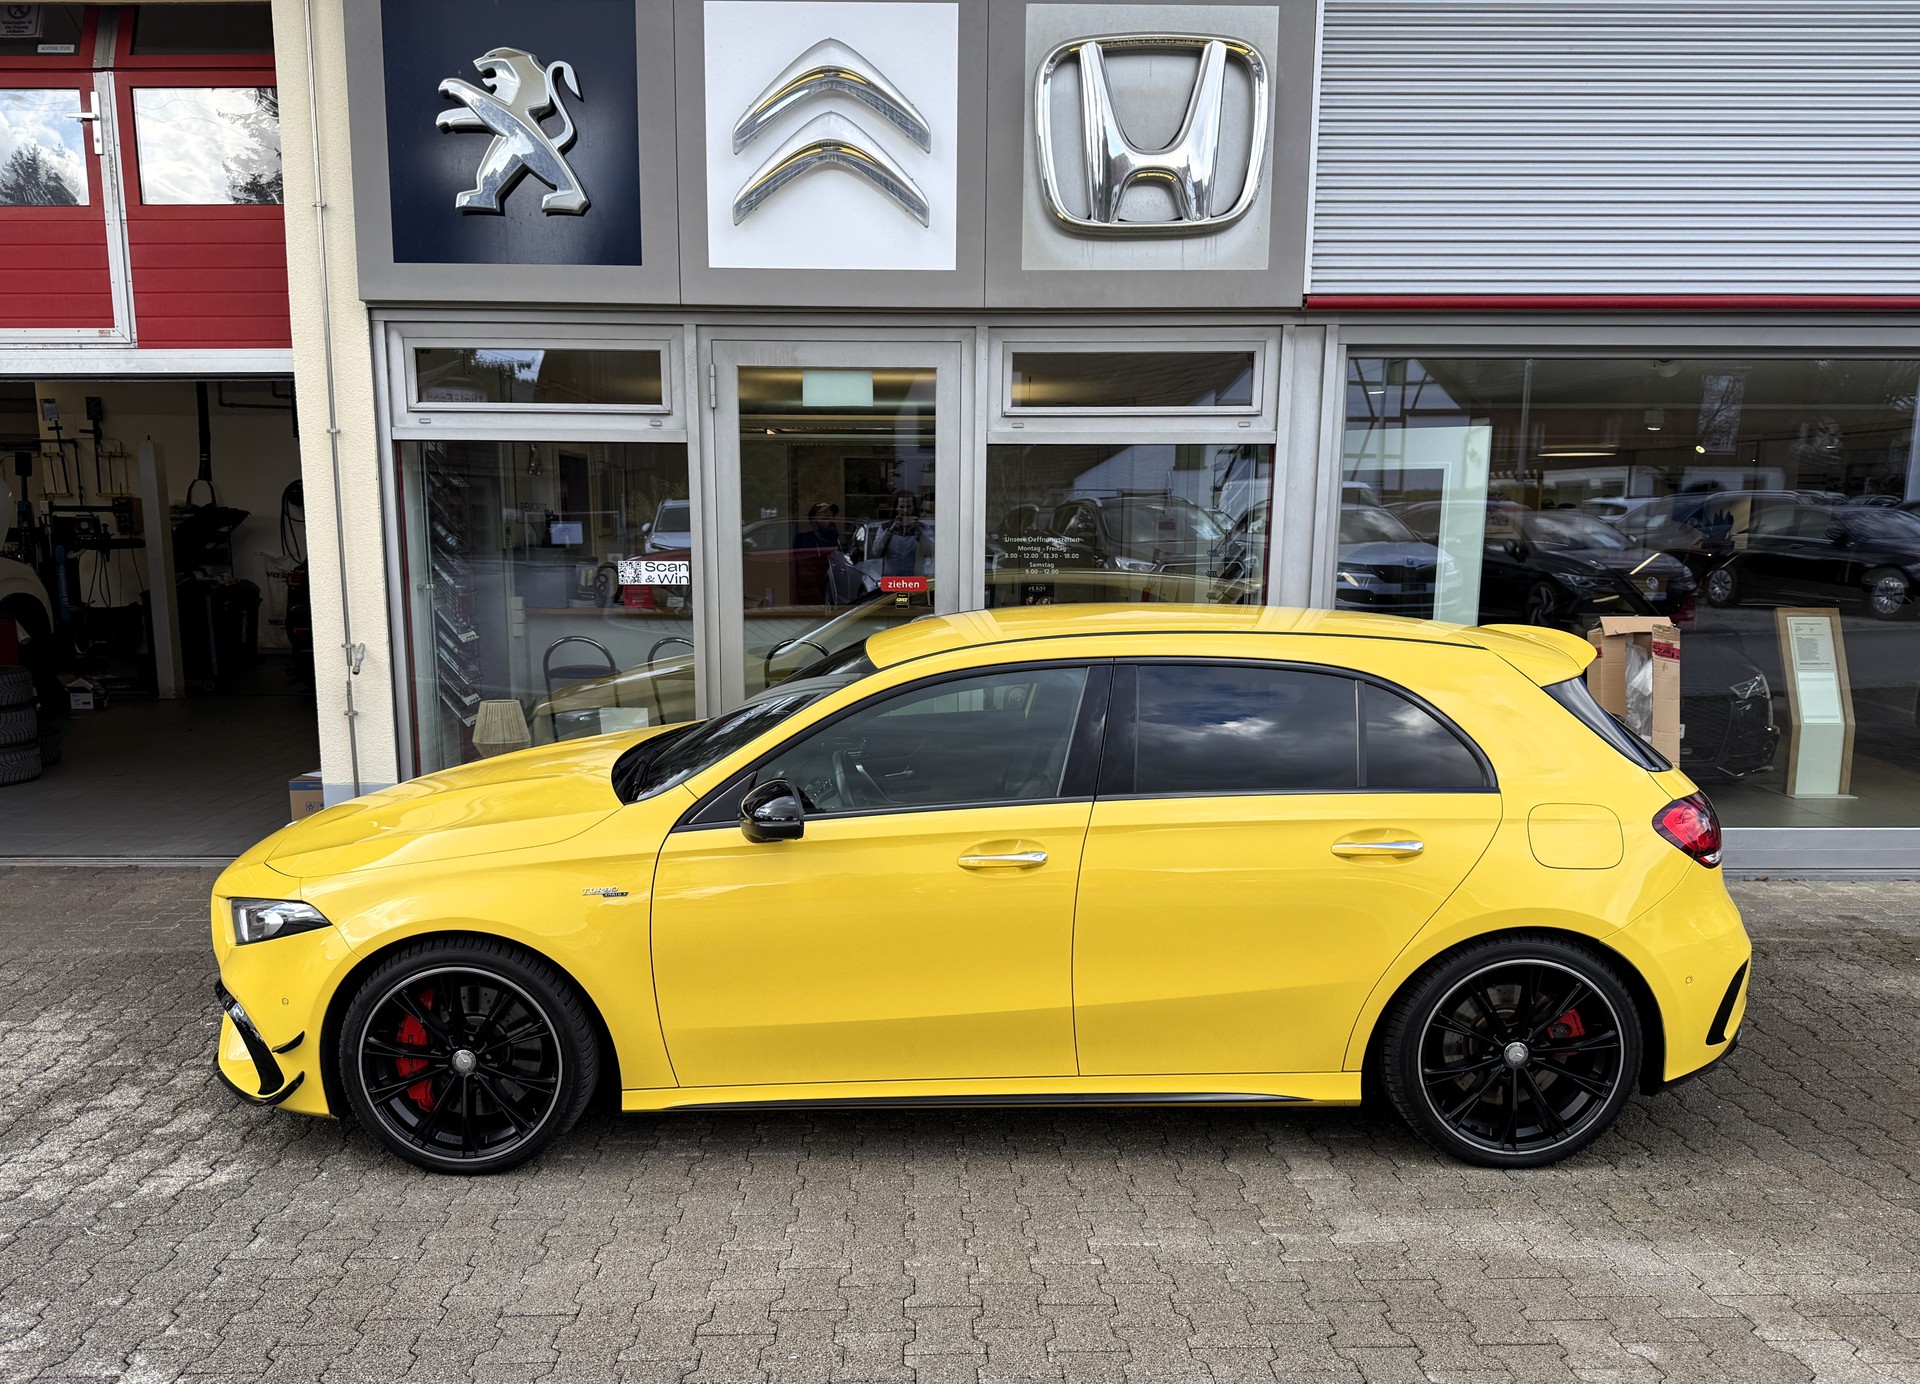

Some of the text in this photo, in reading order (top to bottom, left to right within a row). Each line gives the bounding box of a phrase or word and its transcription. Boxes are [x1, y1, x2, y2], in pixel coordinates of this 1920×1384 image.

[1017, 545, 1041, 553] Montag
[1046, 545, 1067, 553] Freitag
[645, 561, 689, 573] Scan
[645, 573, 689, 584] & Win
[887, 580, 920, 588] ziehen
